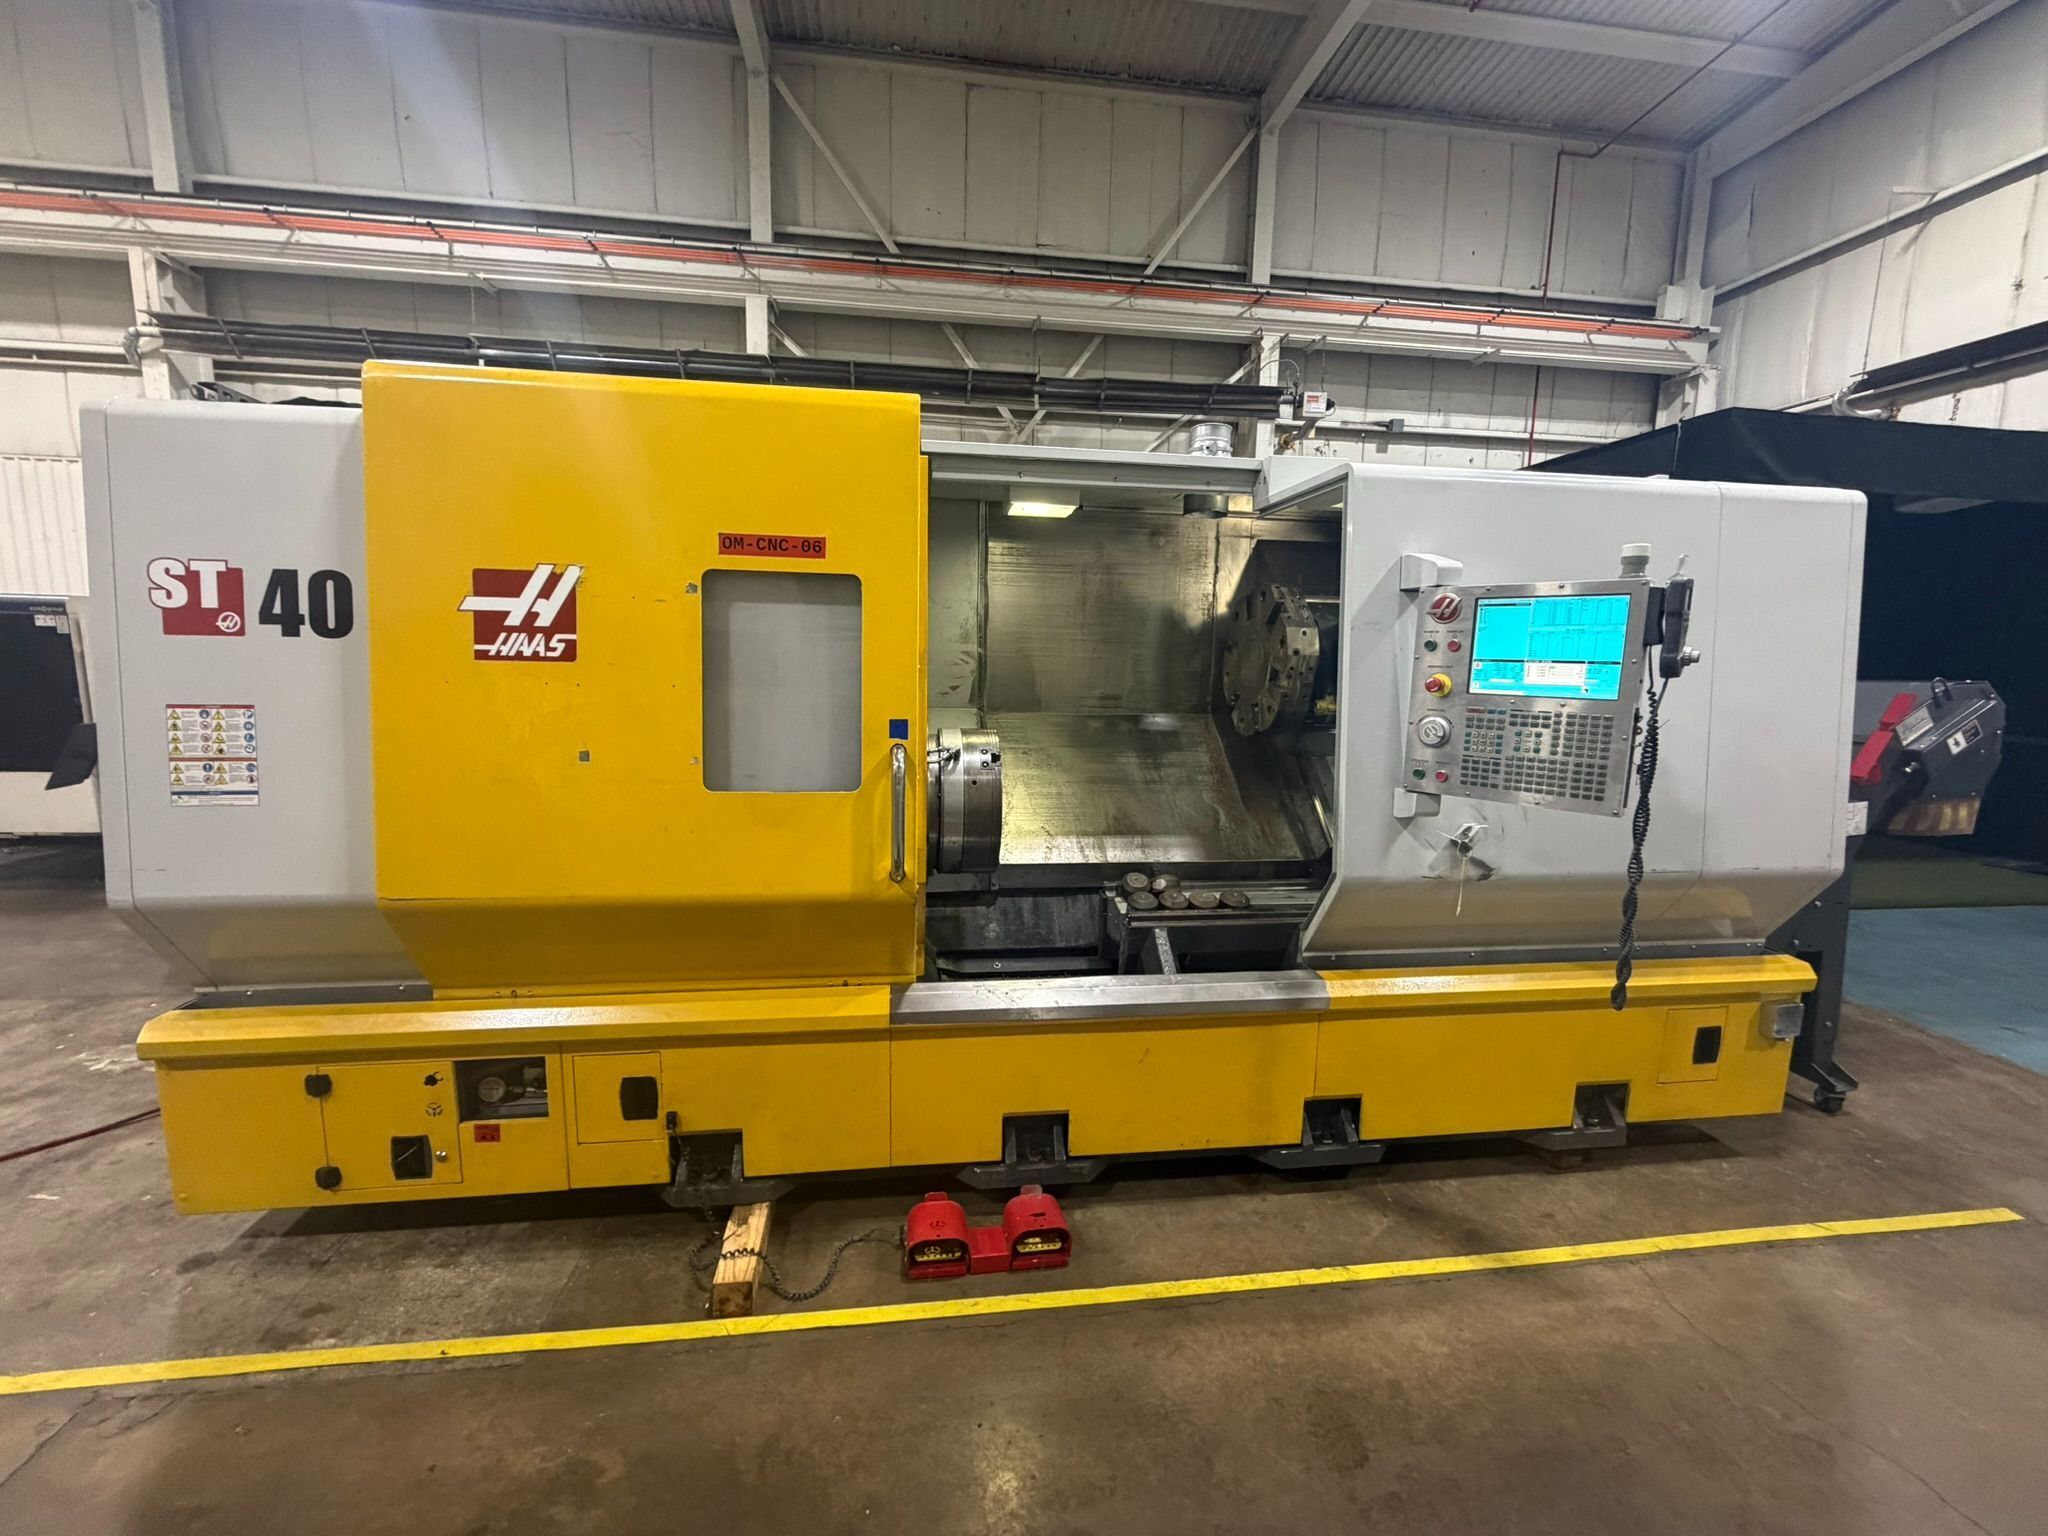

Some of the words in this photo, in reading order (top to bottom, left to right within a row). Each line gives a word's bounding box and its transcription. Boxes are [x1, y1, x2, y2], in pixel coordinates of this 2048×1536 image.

[722, 536, 823, 553] OM-CNC-06
[148, 557, 228, 609] ST
[258, 568, 354, 639] 40
[474, 632, 577, 657] HAAS
